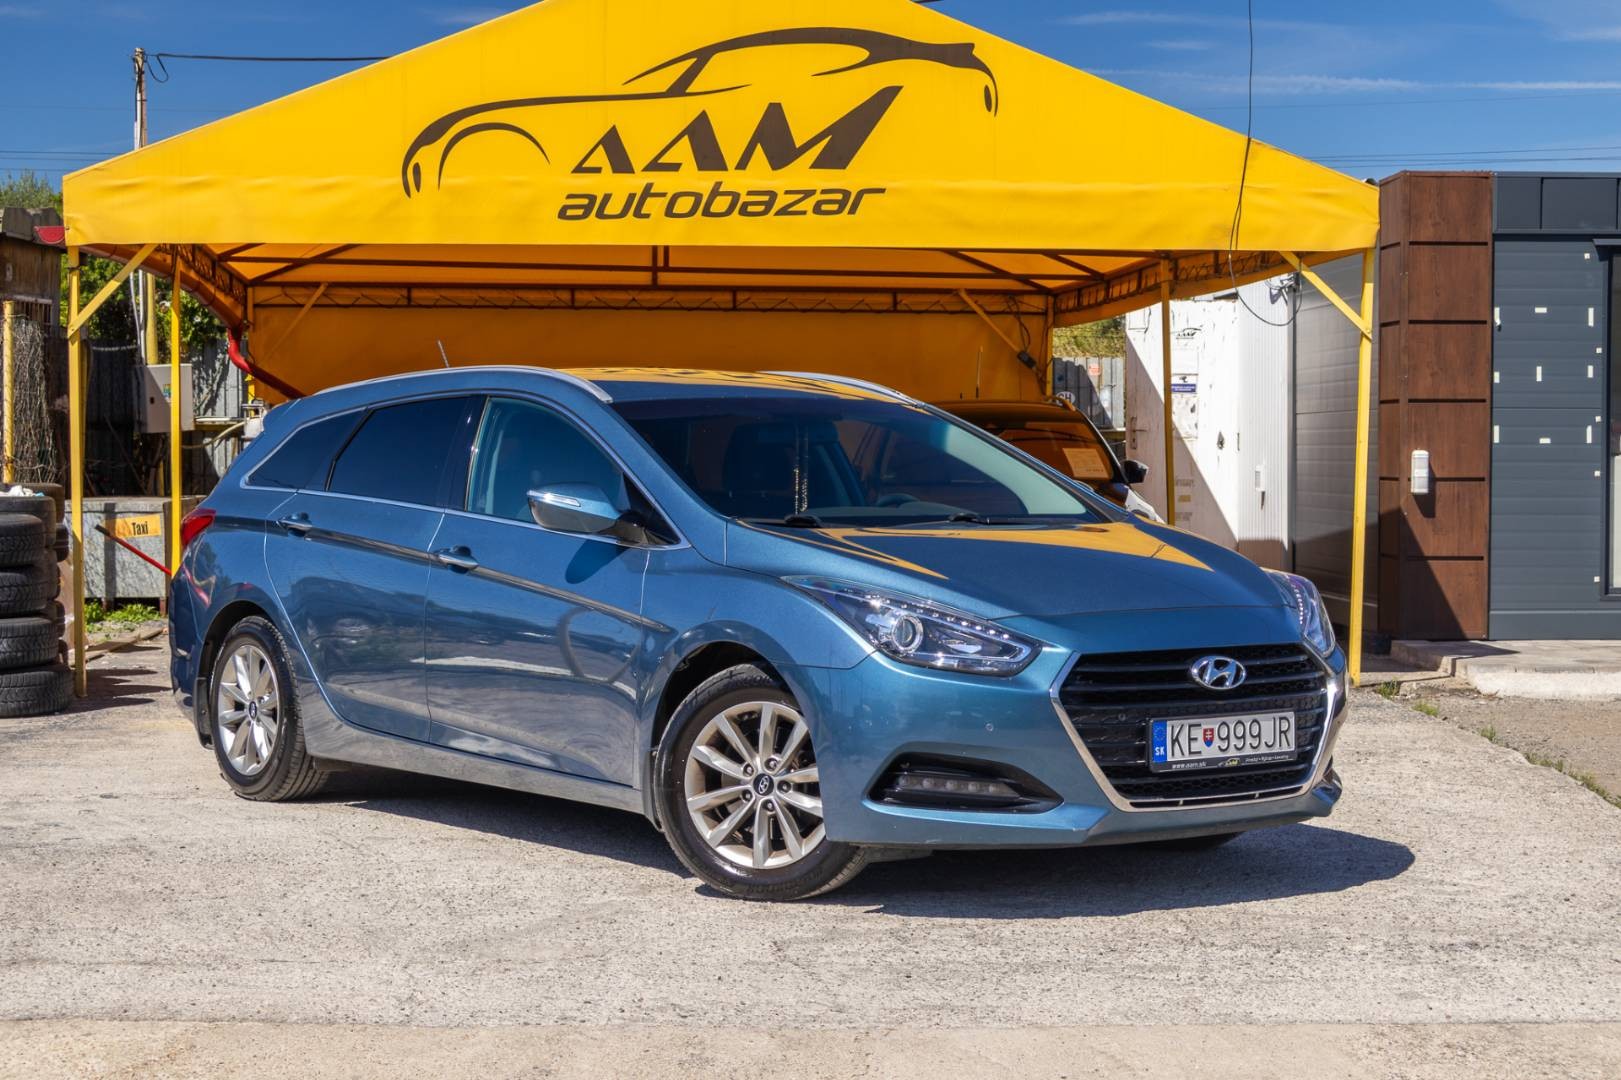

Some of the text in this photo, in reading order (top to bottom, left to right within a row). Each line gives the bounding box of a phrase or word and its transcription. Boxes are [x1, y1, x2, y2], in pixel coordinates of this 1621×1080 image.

[571, 85, 904, 174] AAM
[557, 181, 886, 220] autobazar
[131, 521, 149, 536] Taxi
[1154, 746, 1165, 756] SK
[1170, 716, 1291, 757] KE 999JR
